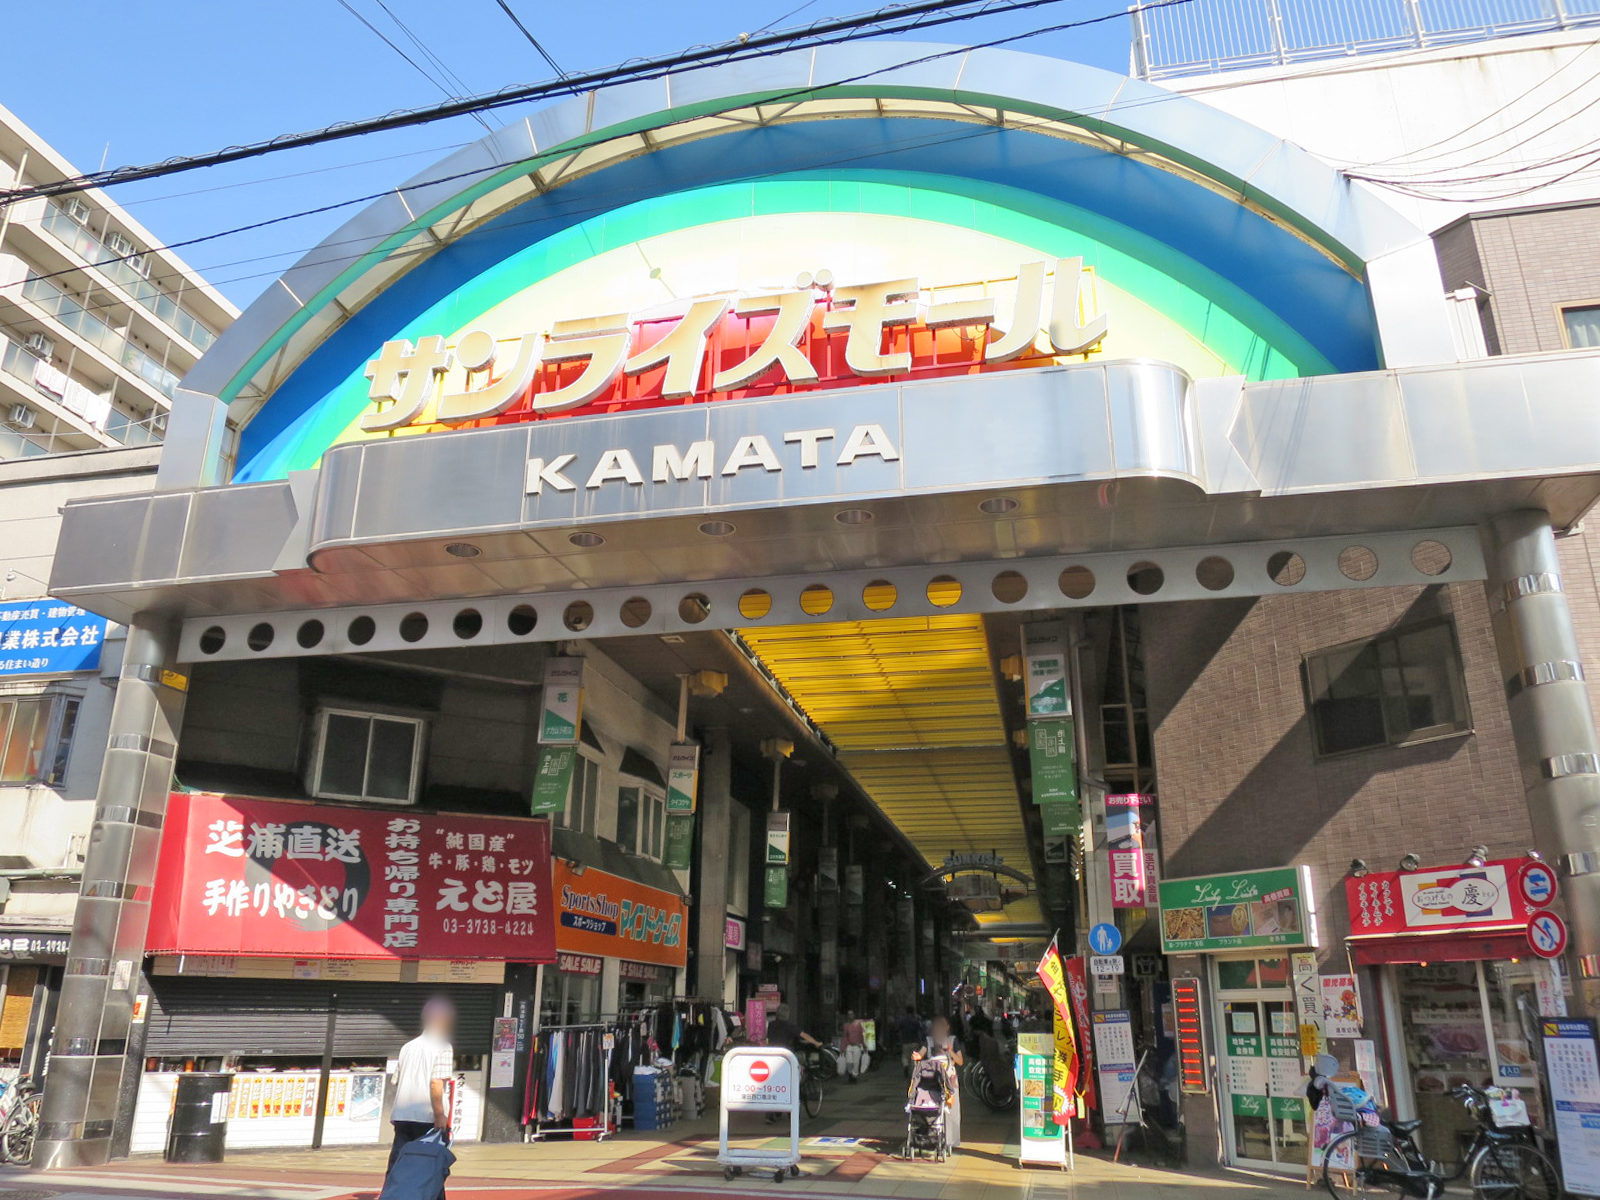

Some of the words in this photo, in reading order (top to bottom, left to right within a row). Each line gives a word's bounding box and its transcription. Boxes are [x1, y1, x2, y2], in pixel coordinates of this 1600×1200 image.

[360, 256, 1108, 433] サンライズモール
[525, 422, 900, 496] KAMATA
[0, 625, 99, 651] 業株式会社
[205, 819, 361, 863] 芝浦直送
[202, 877, 359, 920] 手作りやきとり
[383, 817, 421, 948] お持ち帰り専門店
[436, 877, 538, 916] えど屋
[1112, 852, 1142, 904] 買取
[442, 917, 535, 936] 03-3738-4224
[572, 915, 607, 932] スポーツショップ
[560, 953, 580, 972] SALE
[580, 957, 601, 974] SALE
